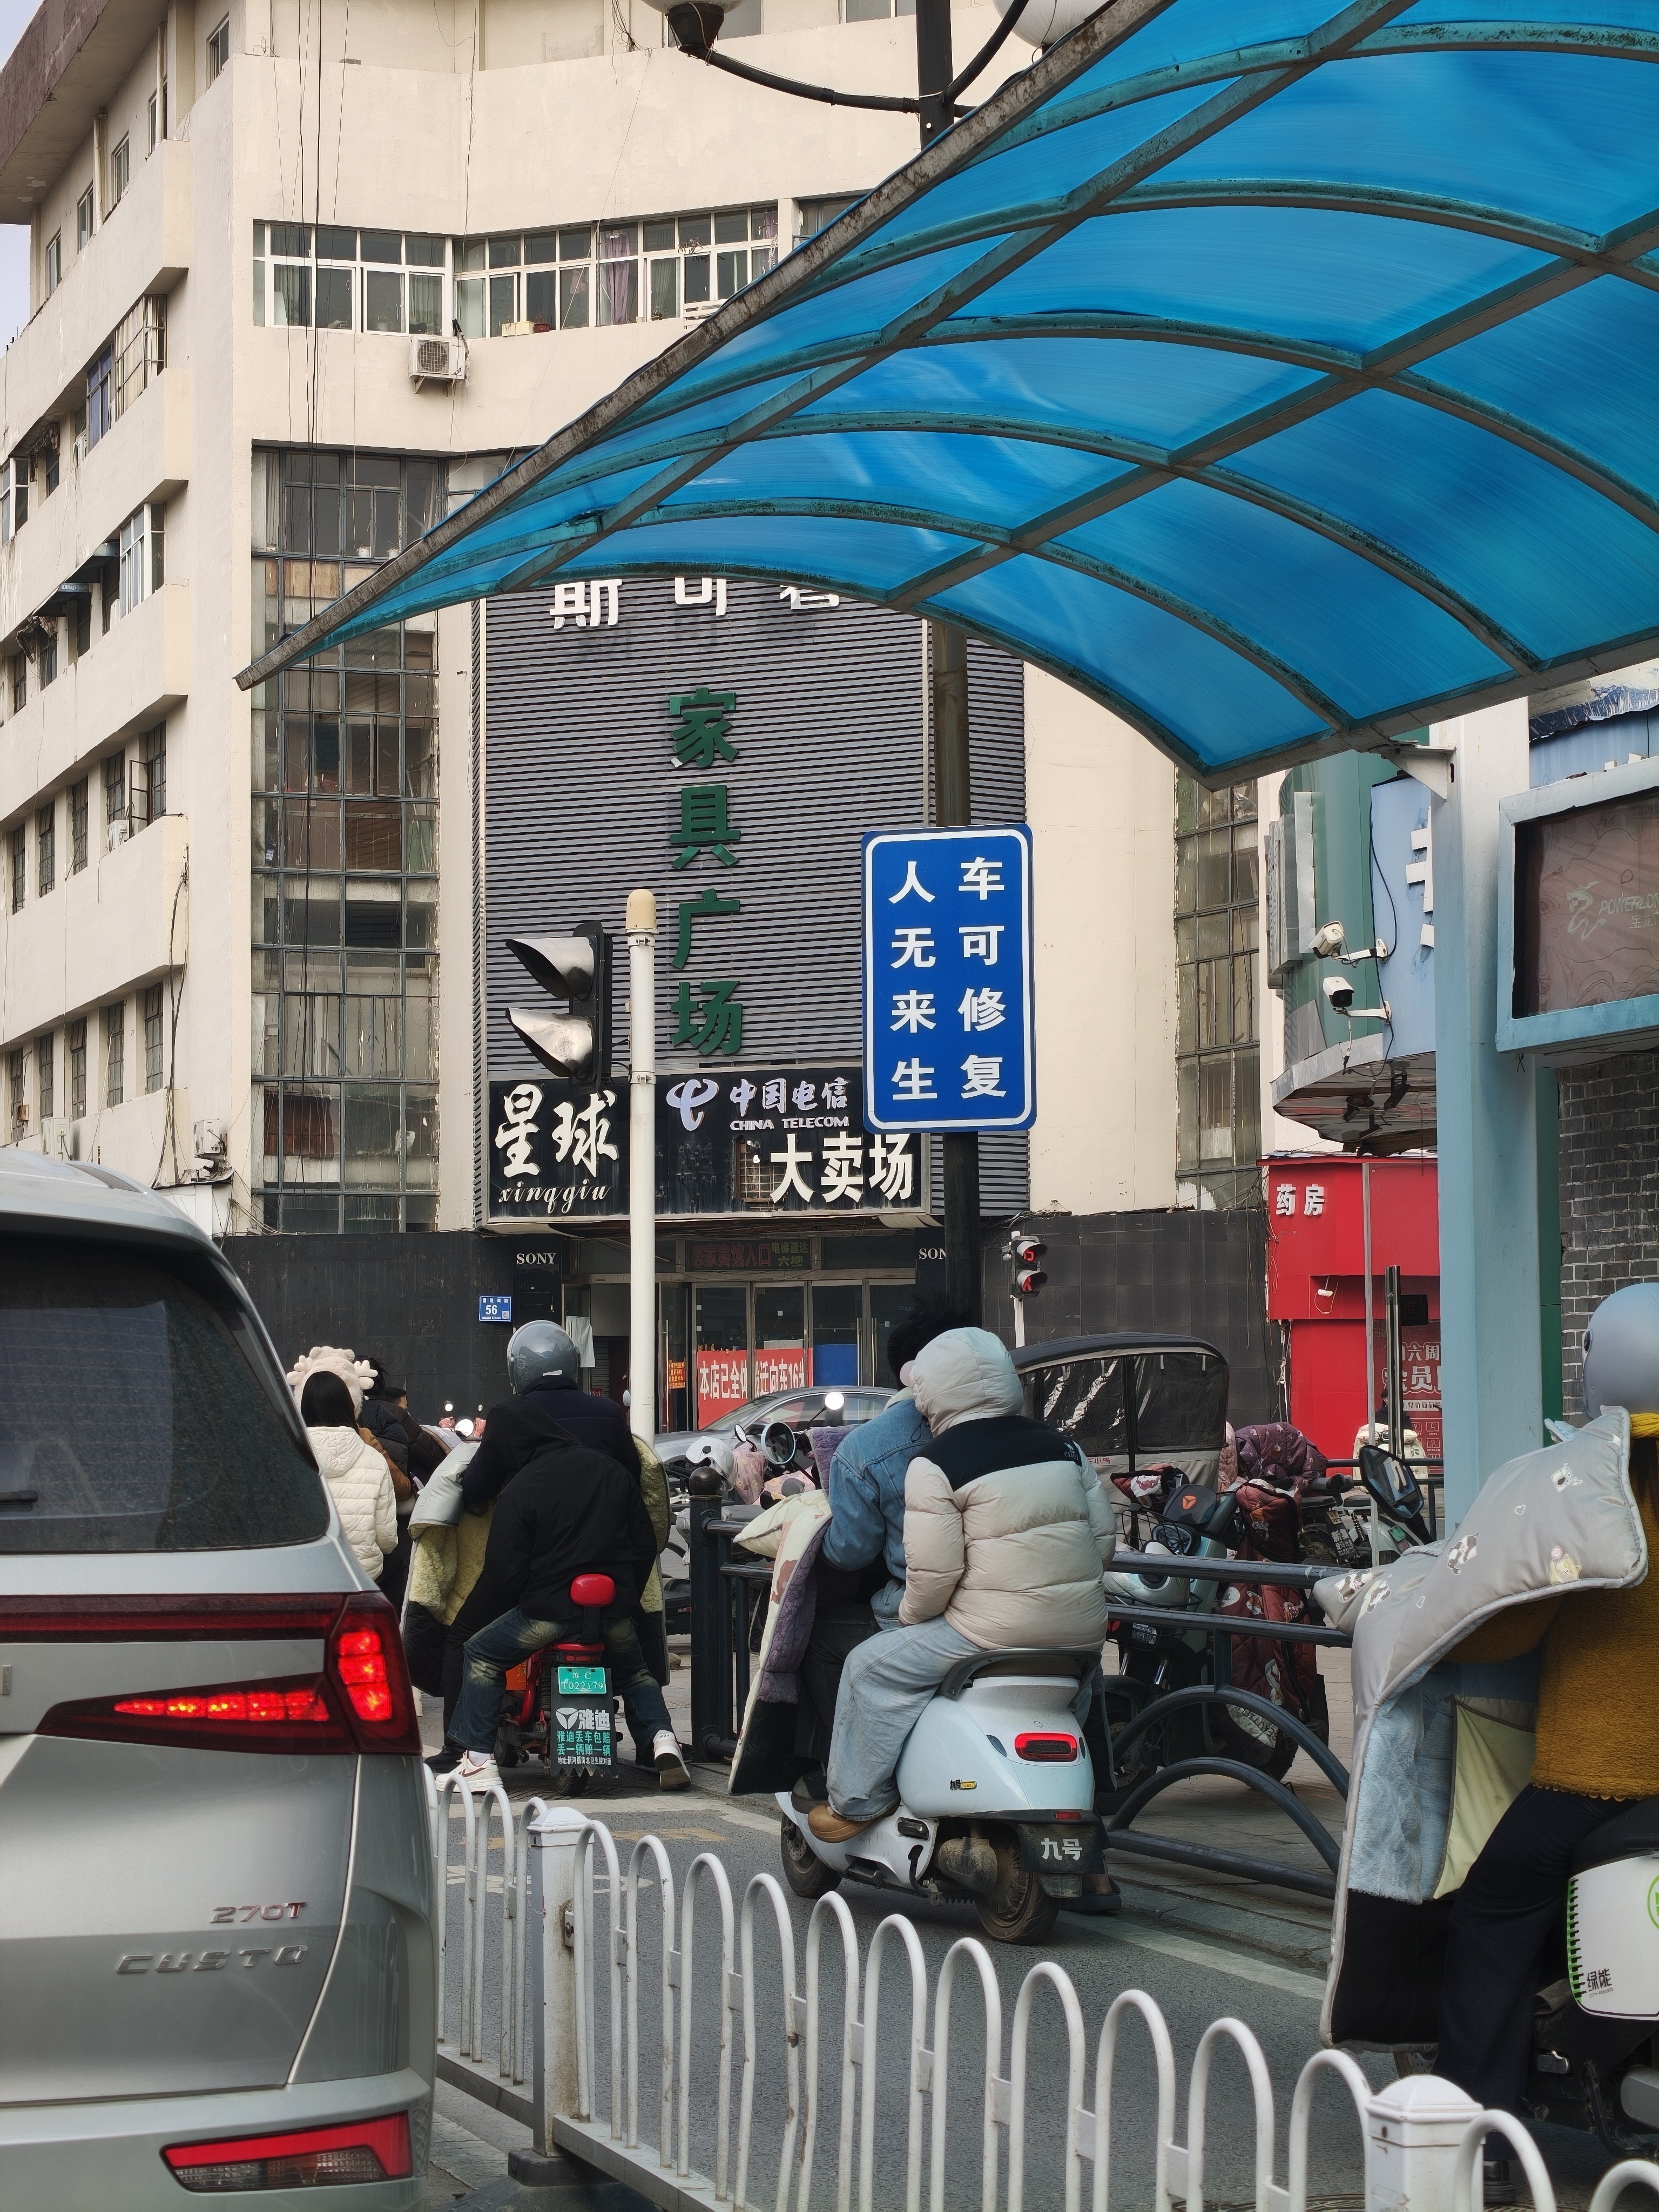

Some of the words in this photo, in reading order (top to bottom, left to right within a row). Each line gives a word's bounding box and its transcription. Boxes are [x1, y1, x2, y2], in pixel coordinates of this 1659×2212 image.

[549, 577, 840, 629] 斯可
[670, 687, 743, 1055] 家具广场
[888, 861, 938, 1101] 人无来生
[958, 857, 1007, 1099] 车可修复
[730, 1077, 848, 1117] 中国电信
[495, 1084, 619, 1177] 星球
[730, 1119, 774, 1131] CHINA
[781, 1116, 849, 1129] TELECOM
[770, 1131, 915, 1204] 大卖场
[1276, 1184, 1325, 1216] 药房
[771, 1240, 808, 1254] 电梯直达
[919, 1248, 946, 1259] SON
[516, 1253, 557, 1264] SONY
[778, 1256, 804, 1267] 六楼
[485, 1304, 497, 1315] 56
[1402, 1345, 1440, 1361] 六周
[561, 1681, 604, 1690] T022179
[578, 1709, 611, 1731] 雅迪
[557, 1731, 611, 1744] 雅迪丢车包赔
[557, 1743, 611, 1757] 丢一辆赔一辆
[1041, 1838, 1082, 1860] 九号
[210, 1902, 308, 1924] 270T
[115, 1944, 309, 1975] CUSTO
[1587, 1968, 1613, 1992] 绿能
